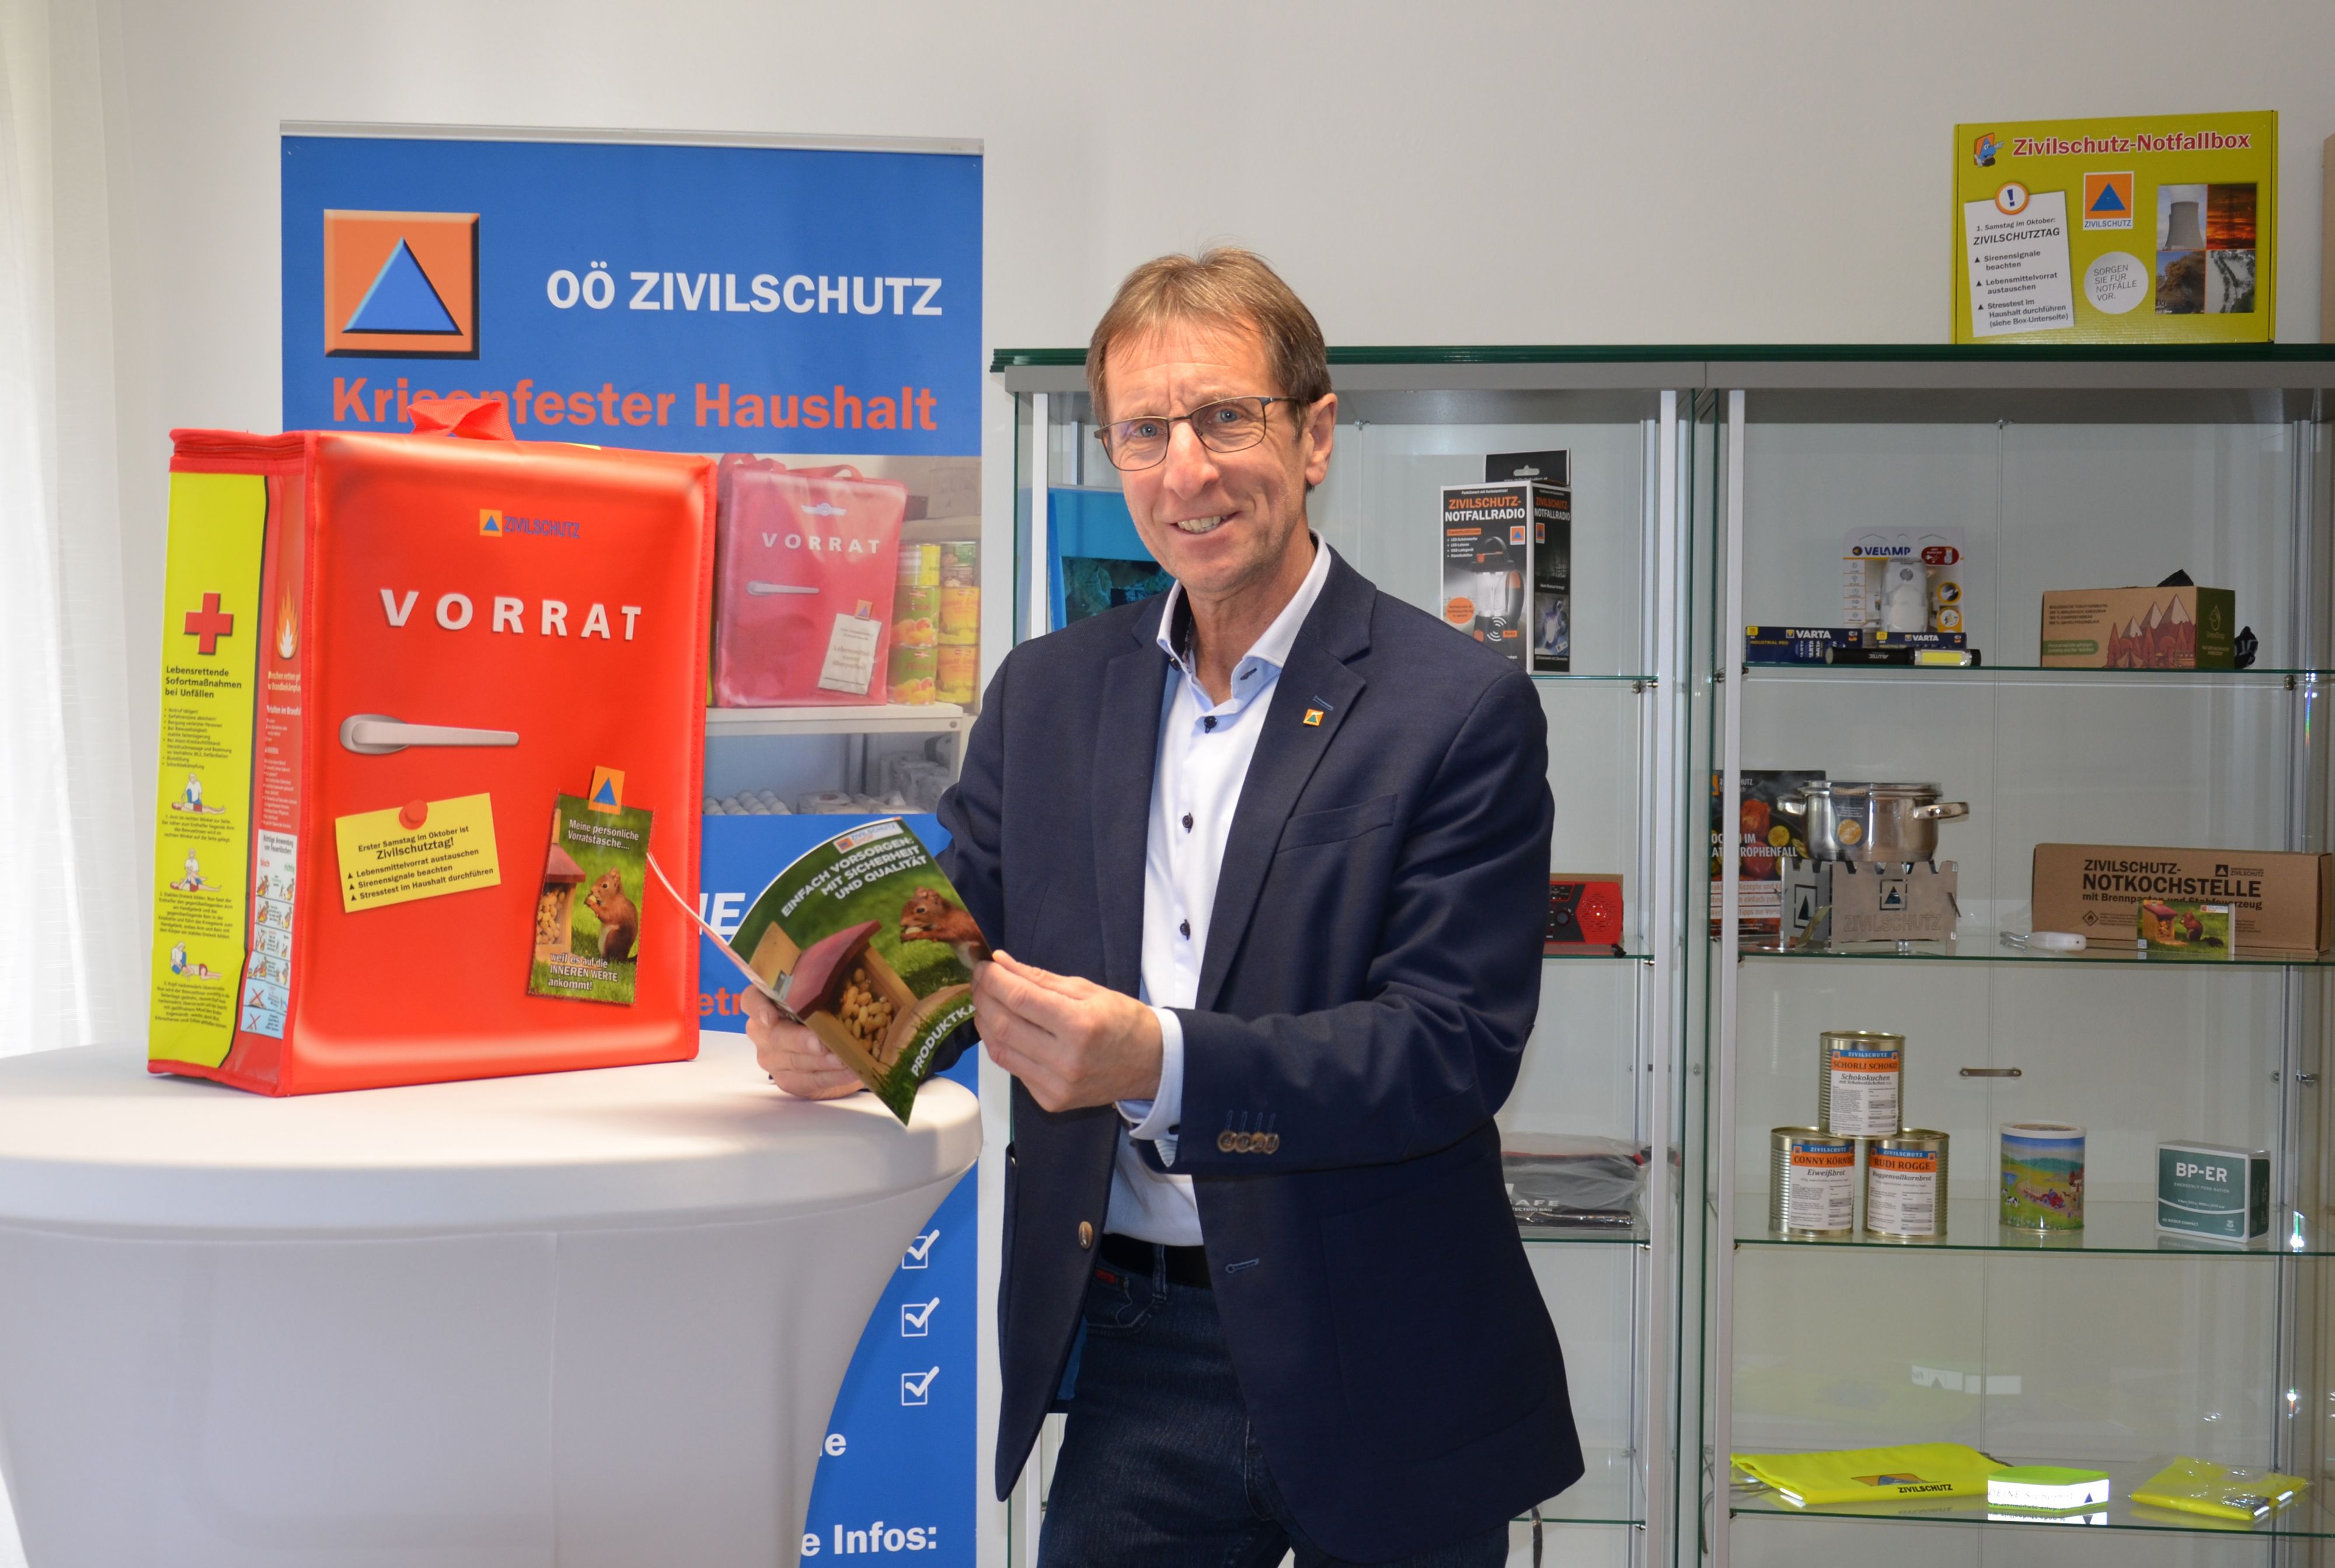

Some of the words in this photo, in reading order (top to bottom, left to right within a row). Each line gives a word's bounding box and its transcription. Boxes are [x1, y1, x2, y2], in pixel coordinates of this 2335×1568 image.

[2012, 131, 2251, 157] Zivilschutz-Notfallbox
[1985, 222, 2015, 231] Samstag
[2026, 218, 2055, 226] Oktober:
[2085, 219, 2132, 228] ZIVILSCHUTZ
[1973, 227, 2060, 246] ZIVILSCHUTZTAG
[1984, 250, 2041, 262] Sirenensignale
[1986, 262, 2022, 271] beachten
[2093, 264, 2128, 277] SORGEN
[1986, 272, 2058, 286] Lebensmittelvorrat
[2094, 276, 2108, 285] SIE
[2110, 272, 2127, 283] FÜR
[546, 260, 616, 311] OÖ
[629, 270, 943, 316] ZIVILSCHUTZ
[1988, 284, 2036, 295] austauschen
[2096, 279, 2138, 294] NOTFÄLLE
[2097, 292, 2116, 302] VOR.
[1988, 299, 2024, 310] Stresstest
[1989, 309, 2021, 318] Haushalt
[2023, 304, 2066, 315] durchführen
[1989, 318, 2012, 328] (siehe
[2013, 312, 2069, 325] Box-Unterseite)
[333, 377, 675, 427] Krifester
[695, 382, 937, 431] Haushalt
[1448, 496, 1522, 510] ZIVILSCHUTZ-
[1445, 508, 1525, 522] NOTFALLRADIO
[1534, 507, 1570, 521] NOTFALLRADIO
[504, 515, 580, 539] ZIVILSCHUTZ
[762, 532, 881, 555] VORRAT
[1864, 546, 1911, 556] VELAMP
[380, 588, 642, 641] VORRAT
[1796, 630, 1831, 639] VARTA
[166, 665, 229, 677] Lebensrettende
[166, 677, 242, 688] Sofortmaßnahmen
[165, 688, 177, 696] bei
[180, 689, 214, 698] Unfällen
[569, 818, 591, 832] Meine
[593, 825, 639, 841] persönliche
[358, 842, 381, 852] Erster
[382, 835, 416, 848] Samstag
[417, 833, 427, 842] im
[428, 828, 458, 839] Oktober
[459, 825, 469, 834] ist
[1744, 833, 1757, 844] IM
[376, 837, 454, 860] Zivilschutztag!
[356, 857, 429, 877] Lebensmittelvorrat
[430, 849, 479, 863] austauschen
[2083, 859, 2181, 875] ZIVILSCHUTZ-
[358, 871, 415, 889] Sirenensignale
[417, 864, 453, 877] beachten
[781, 870, 831, 917] EINFACH
[830, 837, 915, 873] VORSORGEN:
[820, 875, 844, 896] MIT
[844, 845, 921, 879] SICHERHEIT
[835, 879, 863, 900] UND
[865, 855, 927, 883] QUALITÄT
[360, 885, 399, 900] Stresstest
[400, 883, 410, 891] im
[412, 877, 447, 889] Haushalt
[448, 867, 494, 882] durchführen
[2082, 873, 2261, 898] NOTKOCHSTELLE
[2082, 893, 2099, 901] mit
[1843, 914, 1942, 932] ZIVILSCHUTZ
[550, 953, 568, 963] weil
[570, 956, 580, 964] es
[583, 957, 594, 966] auf
[596, 958, 608, 968] die
[550, 964, 589, 978] INNEREN
[591, 970, 618, 982] WERTE
[548, 977, 593, 991] ankommt!
[1841, 1073, 1890, 1081] Schokokuchen
[1793, 1156, 1824, 1164] CONNY
[1874, 1158, 1895, 1168] RUDI
[1898, 1161, 1930, 1170] ROGGE
[1807, 1169, 1845, 1177] Eiweißbrot
[1872, 1170, 1932, 1181] Roggenvollkornbrot
[2176, 1162, 2228, 1183] BP-ER
[1898, 1483, 1953, 1493] ZIVILSCHUTZ
[834, 1520, 938, 1556] Infos:
